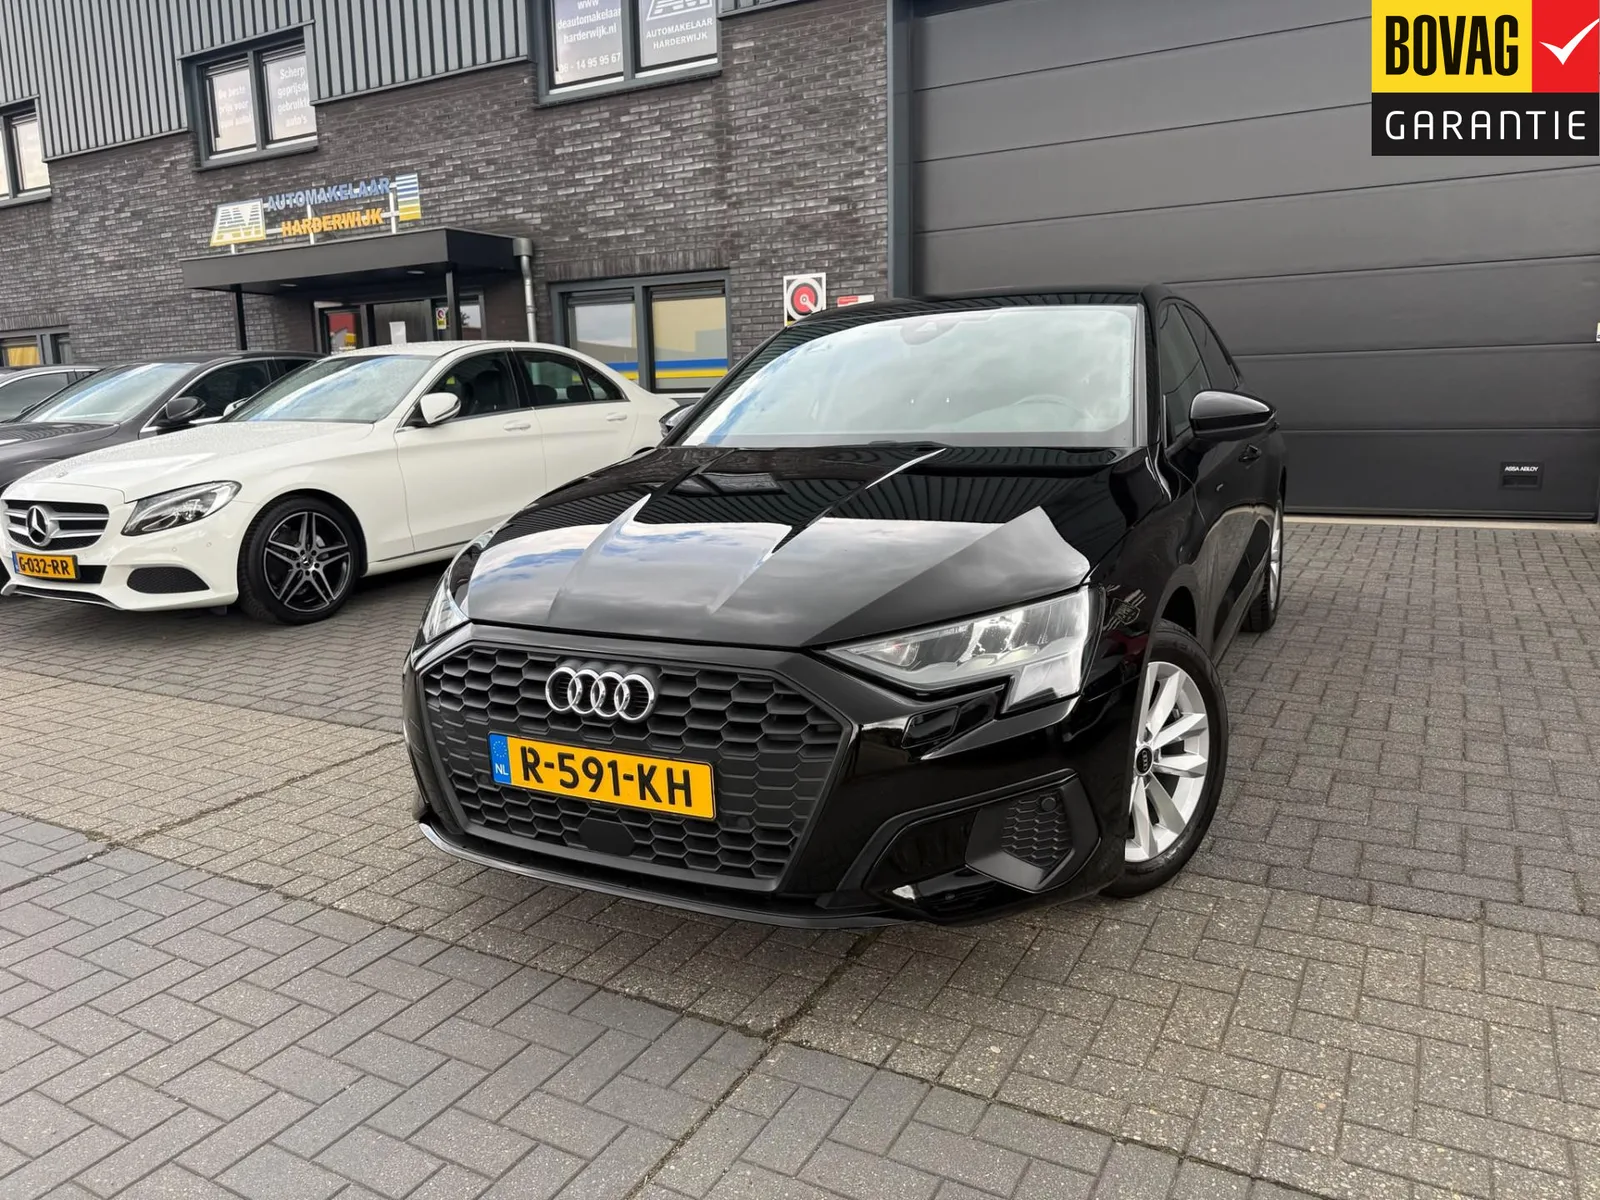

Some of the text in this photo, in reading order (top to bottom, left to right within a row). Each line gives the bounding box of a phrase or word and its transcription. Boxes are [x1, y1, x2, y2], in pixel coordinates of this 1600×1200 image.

[557, 7, 621, 30] deautomakelaar
[646, 17, 713, 39] AUTOMAKELAAR
[563, 22, 617, 44] harderwijk.nl
[653, 32, 708, 50] HARDERWIJK
[599, 54, 610, 65] 95
[611, 52, 621, 63] 67
[280, 66, 305, 80] Scherp
[266, 177, 390, 213] AUTOMAKELAAR
[281, 207, 384, 238] HARDERWIJK
[18, 556, 71, 576] G-032-RR
[494, 763, 509, 776] NL
[520, 745, 693, 808] R-591-KH
